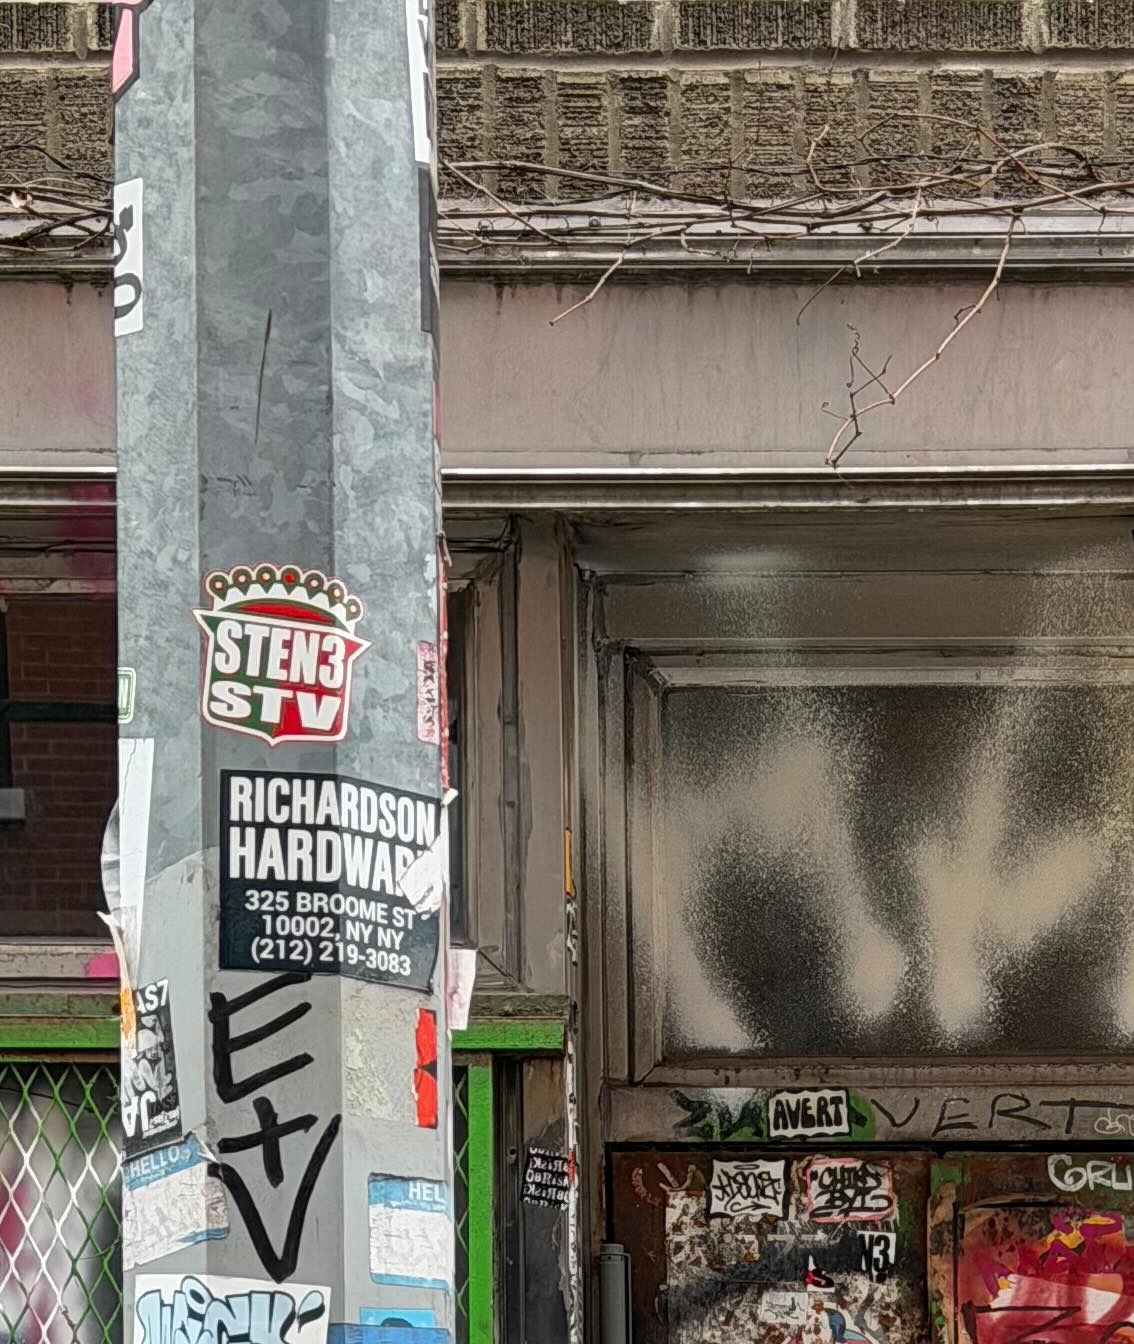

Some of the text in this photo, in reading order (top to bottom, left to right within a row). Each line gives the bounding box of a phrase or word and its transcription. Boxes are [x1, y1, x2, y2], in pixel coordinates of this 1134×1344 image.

[215, 619, 346, 688] STEN3
[209, 681, 343, 731] STV
[229, 776, 436, 846] RICHARDSON
[229, 826, 424, 898] HARDWAR
[245, 891, 417, 930] 325 BROOME ST
[262, 914, 405, 950] 10002, NY NY
[251, 938, 412, 976] (212) 219-3083
[772, 1095, 845, 1130] AVERT
